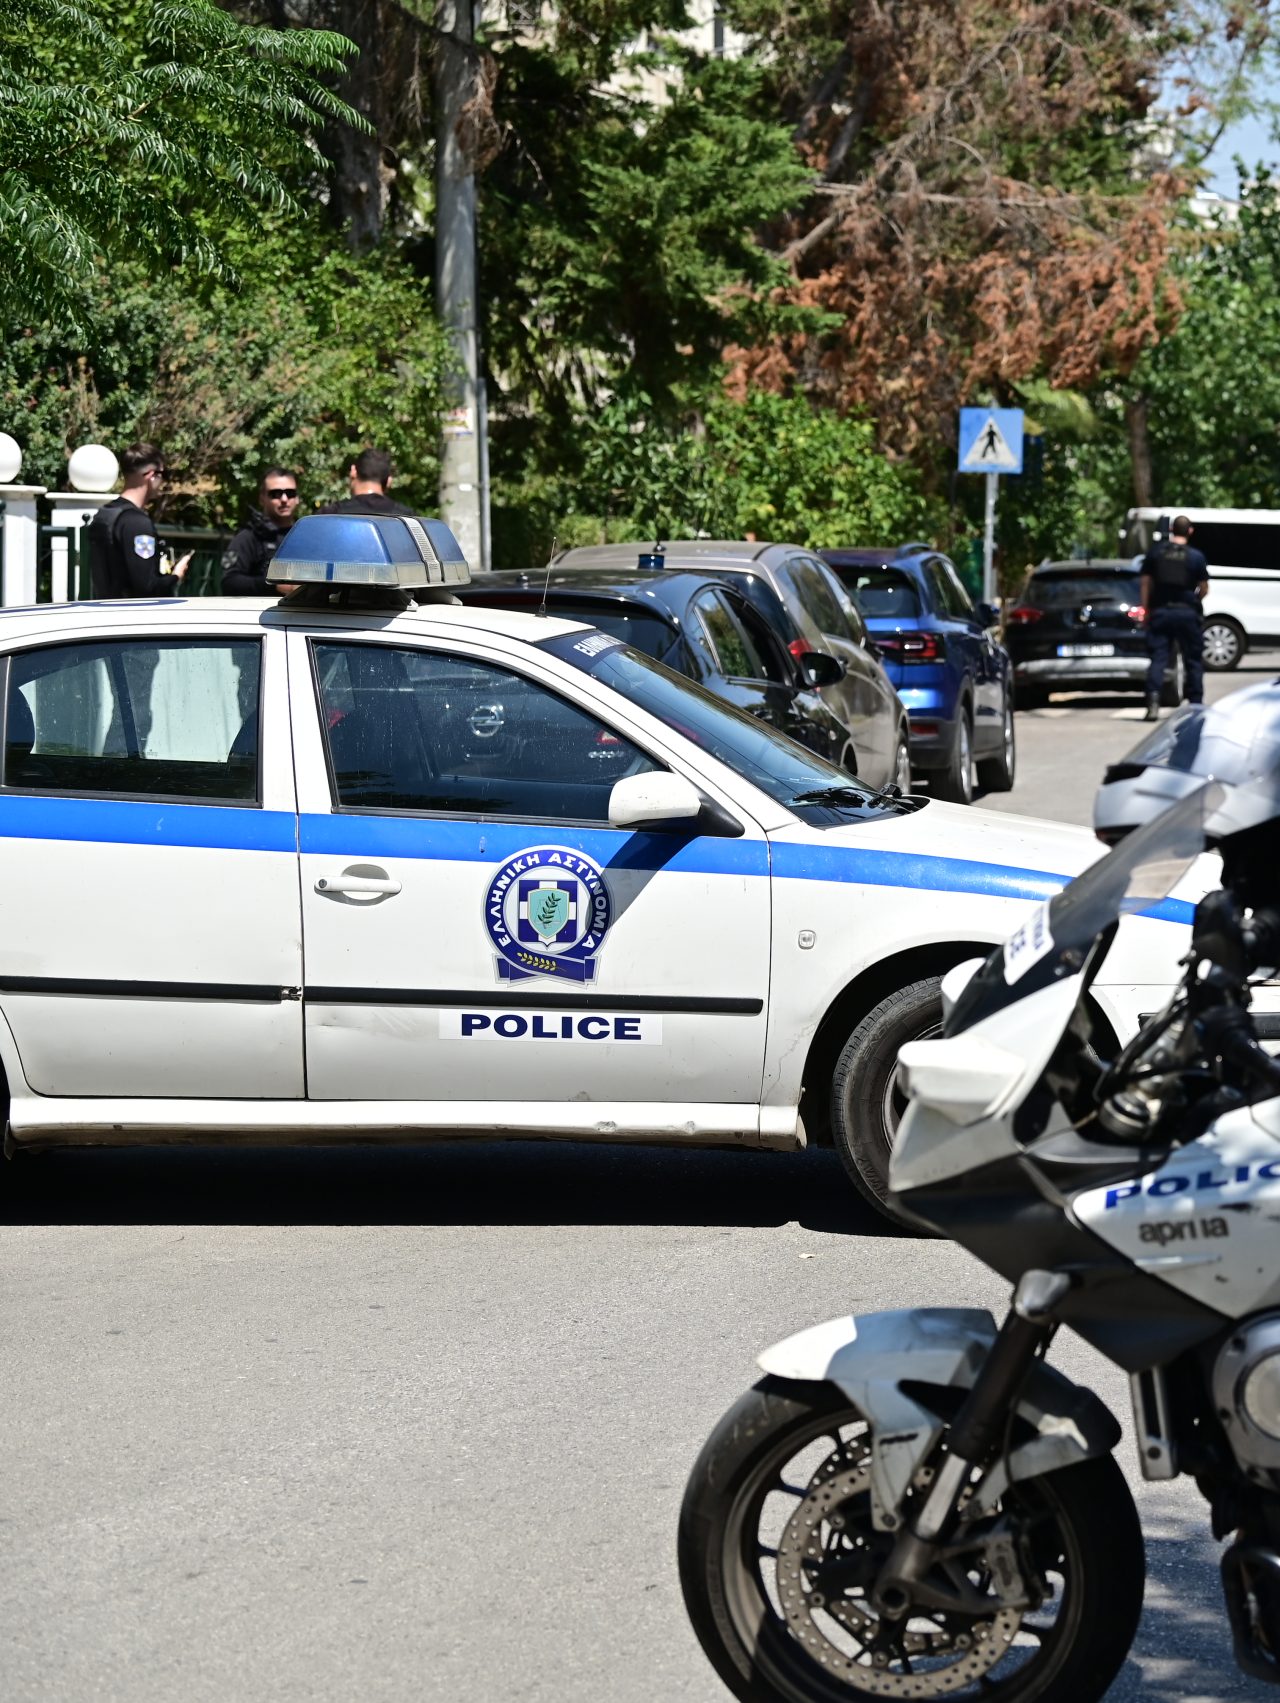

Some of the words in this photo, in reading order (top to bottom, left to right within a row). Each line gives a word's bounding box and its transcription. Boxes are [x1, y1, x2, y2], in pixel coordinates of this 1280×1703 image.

[490, 852, 541, 948] ΕΛΛΗΝΙΚΗ
[548, 852, 607, 949] ΑΣΤΥΝΟΜΙΑ
[461, 1013, 642, 1041] POLICE
